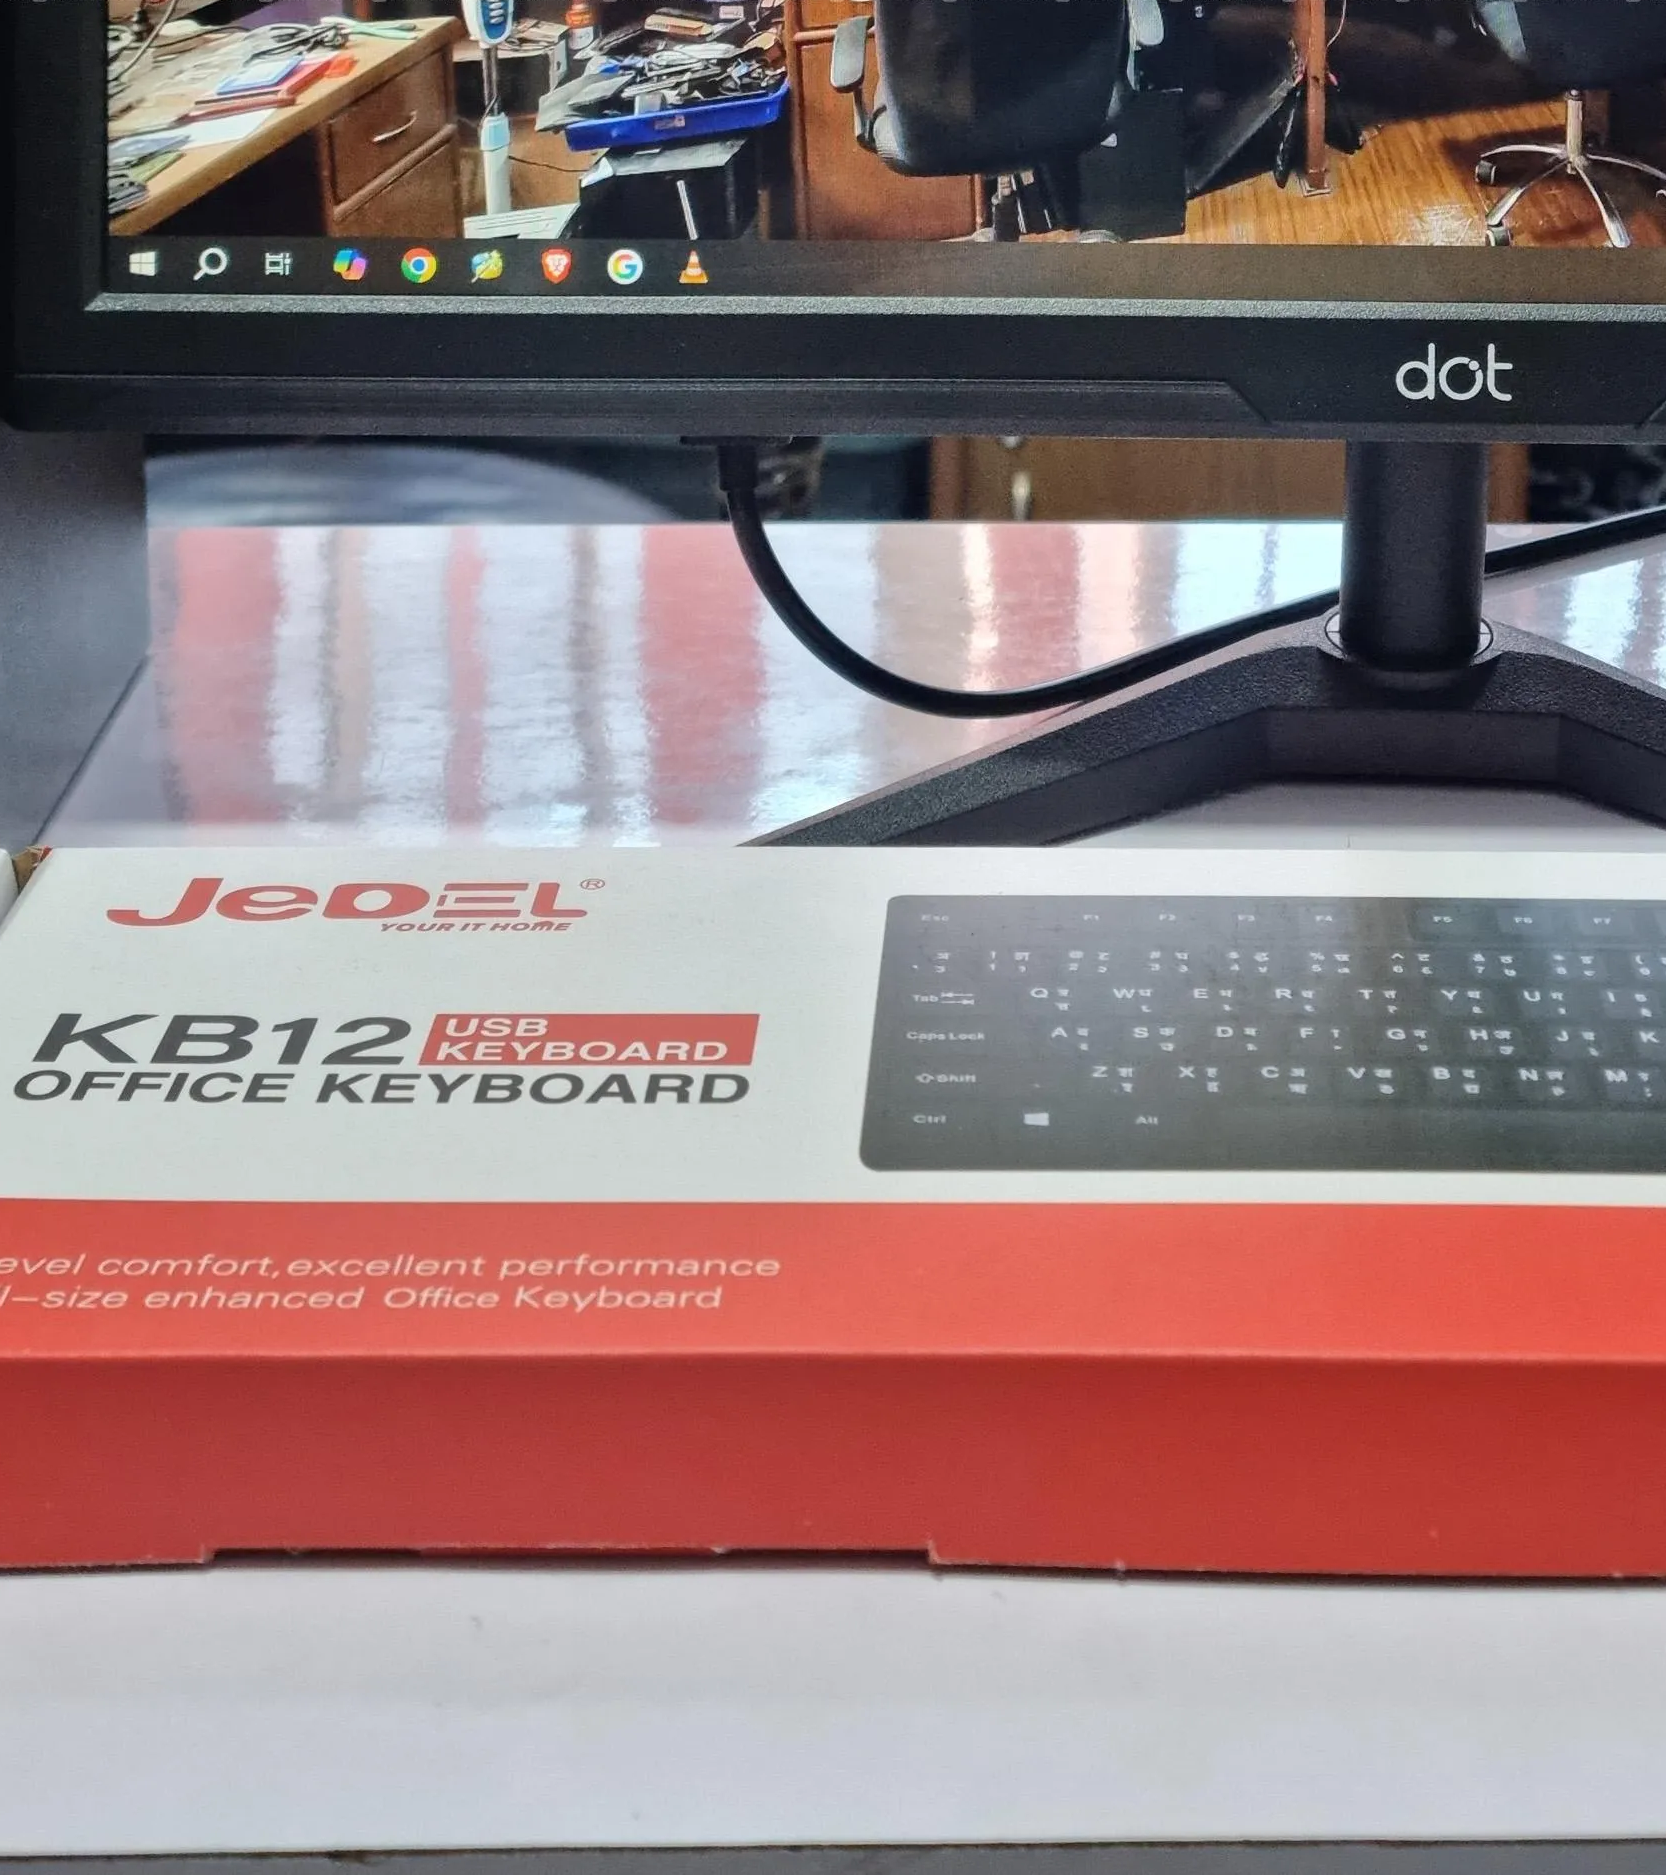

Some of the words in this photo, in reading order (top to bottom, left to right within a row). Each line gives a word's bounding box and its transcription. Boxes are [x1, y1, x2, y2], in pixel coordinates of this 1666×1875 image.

[1395, 342, 1513, 401] dot
[381, 923, 456, 932] YOUR
[459, 923, 487, 932] IT
[489, 921, 573, 932] HOME
[1030, 987, 1049, 999] Q
[1113, 988, 1135, 999] W
[1192, 988, 1209, 999] E
[1274, 988, 1293, 1000] R
[1357, 989, 1374, 1000] T
[1440, 989, 1459, 1001] Y
[1522, 990, 1541, 1002] U
[31, 1012, 413, 1066] KB12
[445, 1017, 548, 1038] USB
[948, 1030, 985, 1041] Lock
[1050, 1027, 1069, 1039] A
[1132, 1027, 1150, 1039] S
[1215, 1027, 1234, 1038] D
[1299, 1027, 1314, 1039] F
[1386, 1028, 1406, 1040] G
[1469, 1029, 1489, 1041] H
[1556, 1030, 1569, 1042] J
[1639, 1030, 1660, 1043] K
[434, 1040, 729, 1063] KEYBOARD
[1092, 1066, 1109, 1078] Z
[1179, 1066, 1196, 1078] X
[1260, 1066, 1280, 1078] C
[1346, 1067, 1366, 1079] V
[1432, 1067, 1451, 1080] B
[1518, 1069, 1539, 1081] N
[1604, 1069, 1628, 1083] M
[13, 1070, 290, 1104] OFFICE
[314, 1072, 752, 1105] KEYBOARD
[497, 1254, 781, 1281] performance
[144, 1285, 366, 1309] enhanced
[383, 1286, 500, 1309] Office
[513, 1285, 723, 1313] Keyboard
